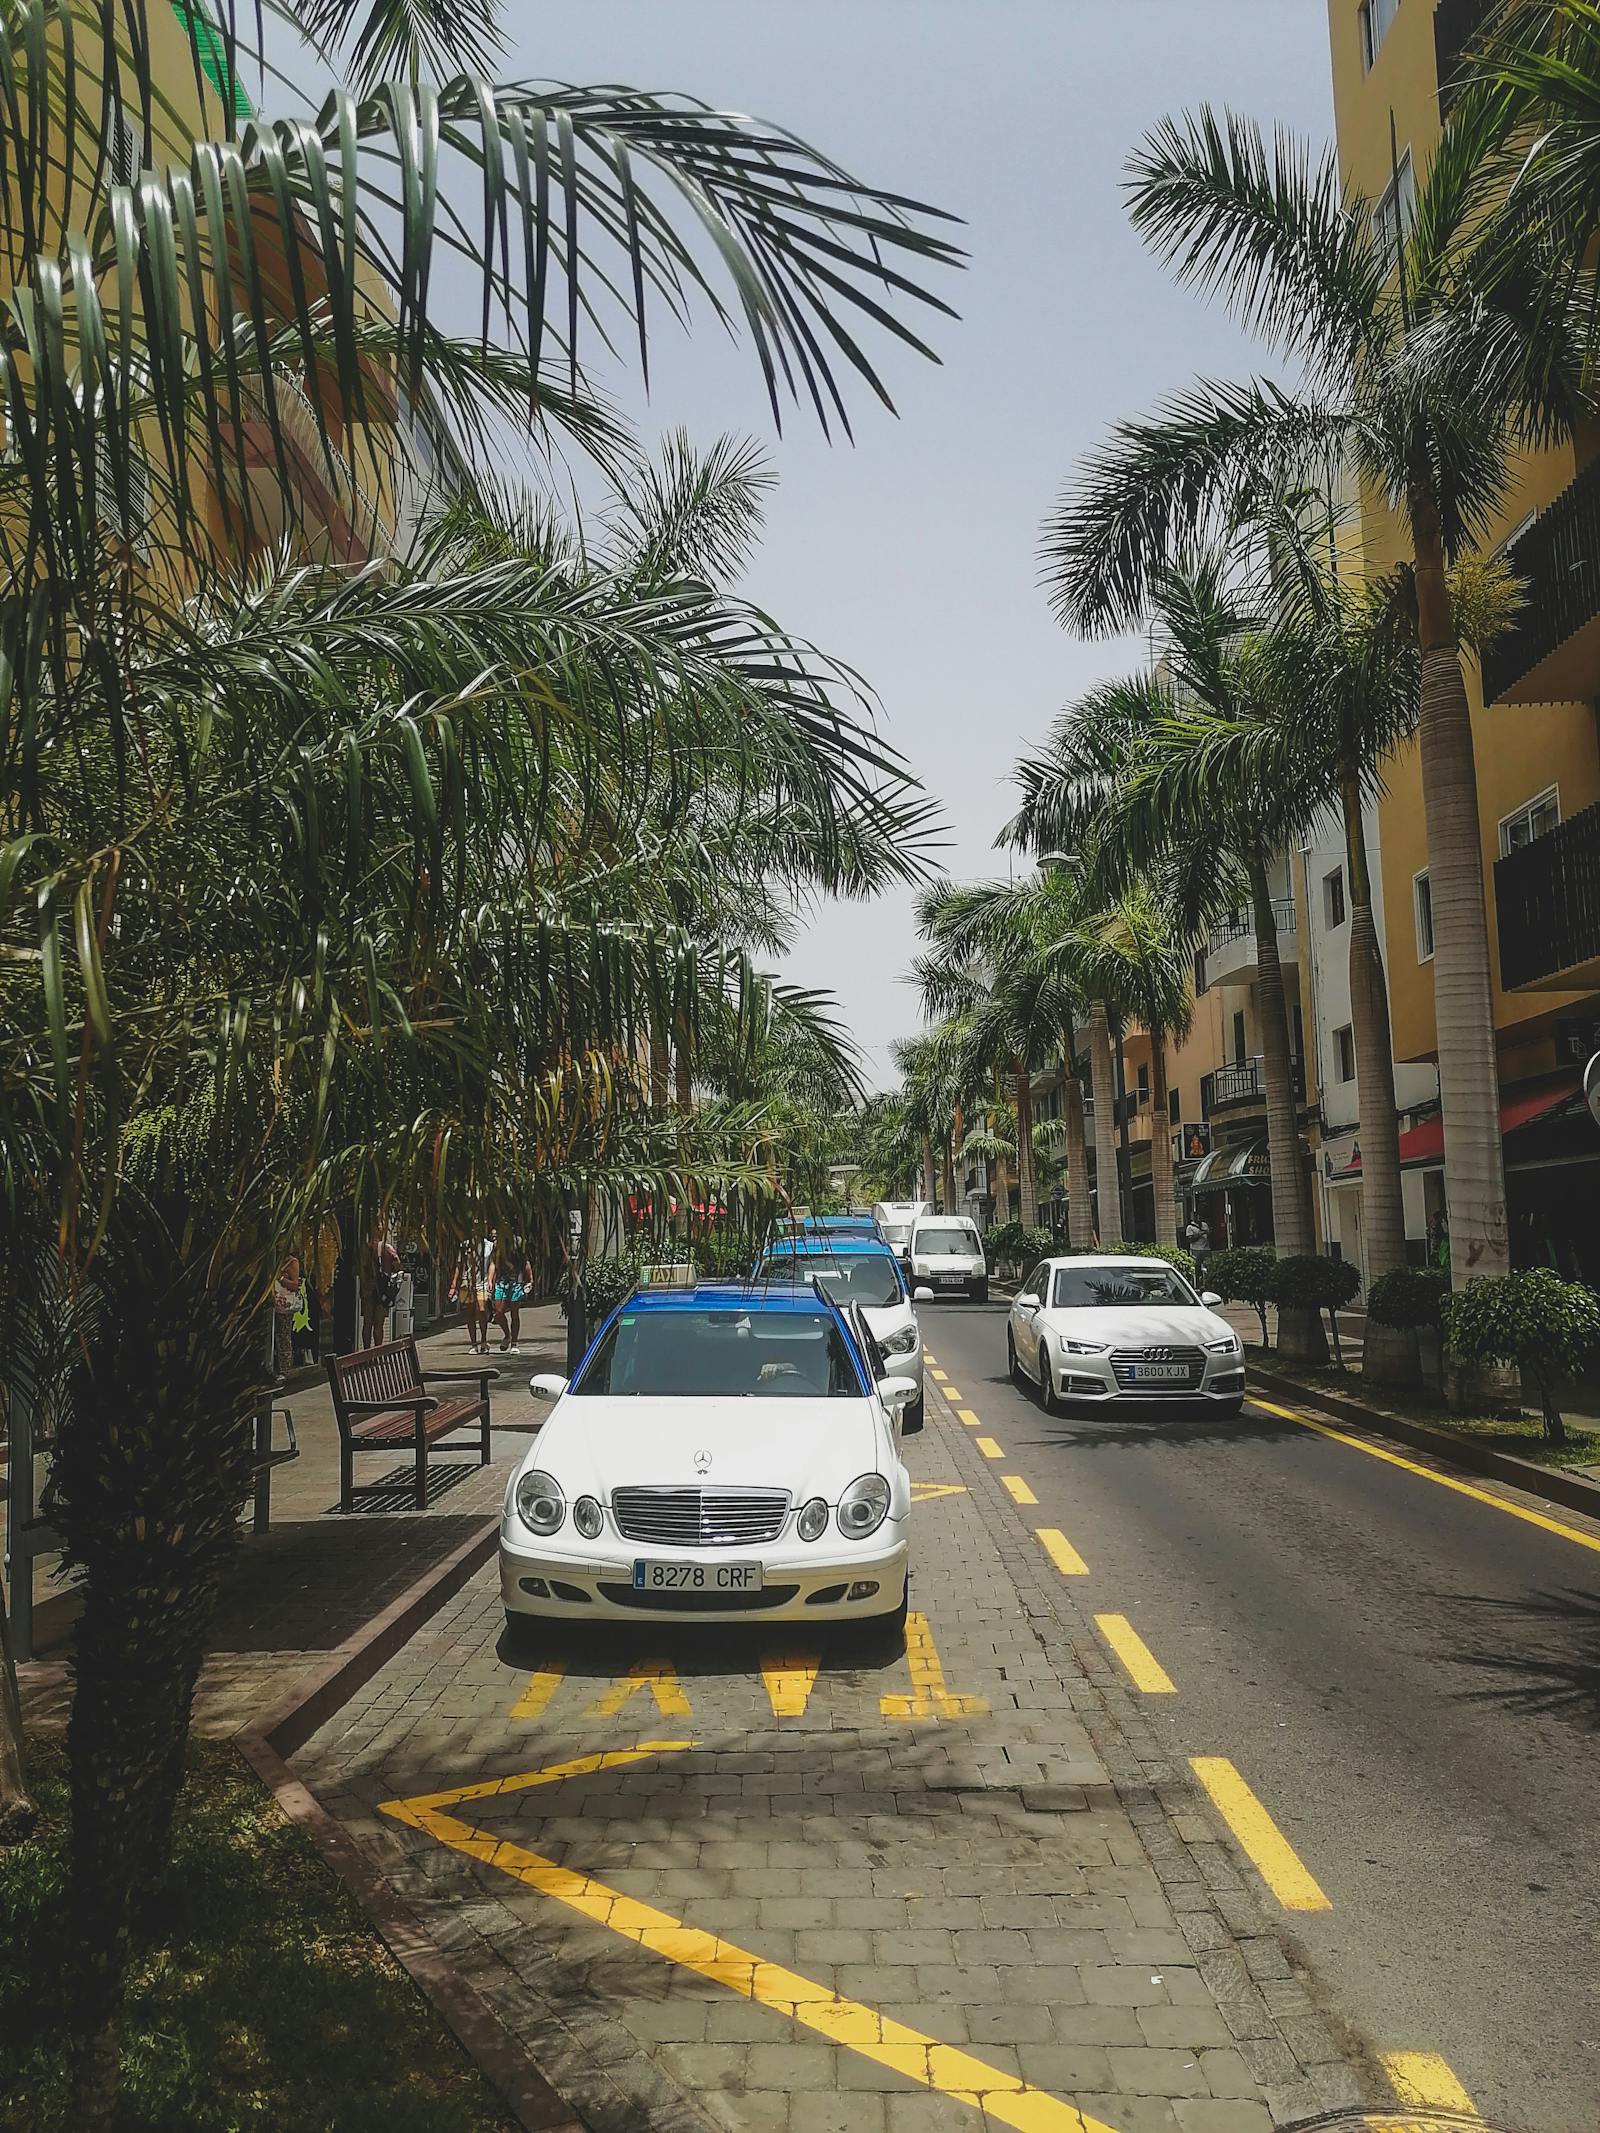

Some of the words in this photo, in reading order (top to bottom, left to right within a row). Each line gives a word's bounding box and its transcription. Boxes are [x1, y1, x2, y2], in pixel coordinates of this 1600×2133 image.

[651, 1269, 677, 1282] TAXI
[1137, 1366, 1164, 1377] 3600
[1166, 1366, 1186, 1377] KJX
[652, 1566, 705, 1588] 8278
[716, 1567, 756, 1588] CRF
